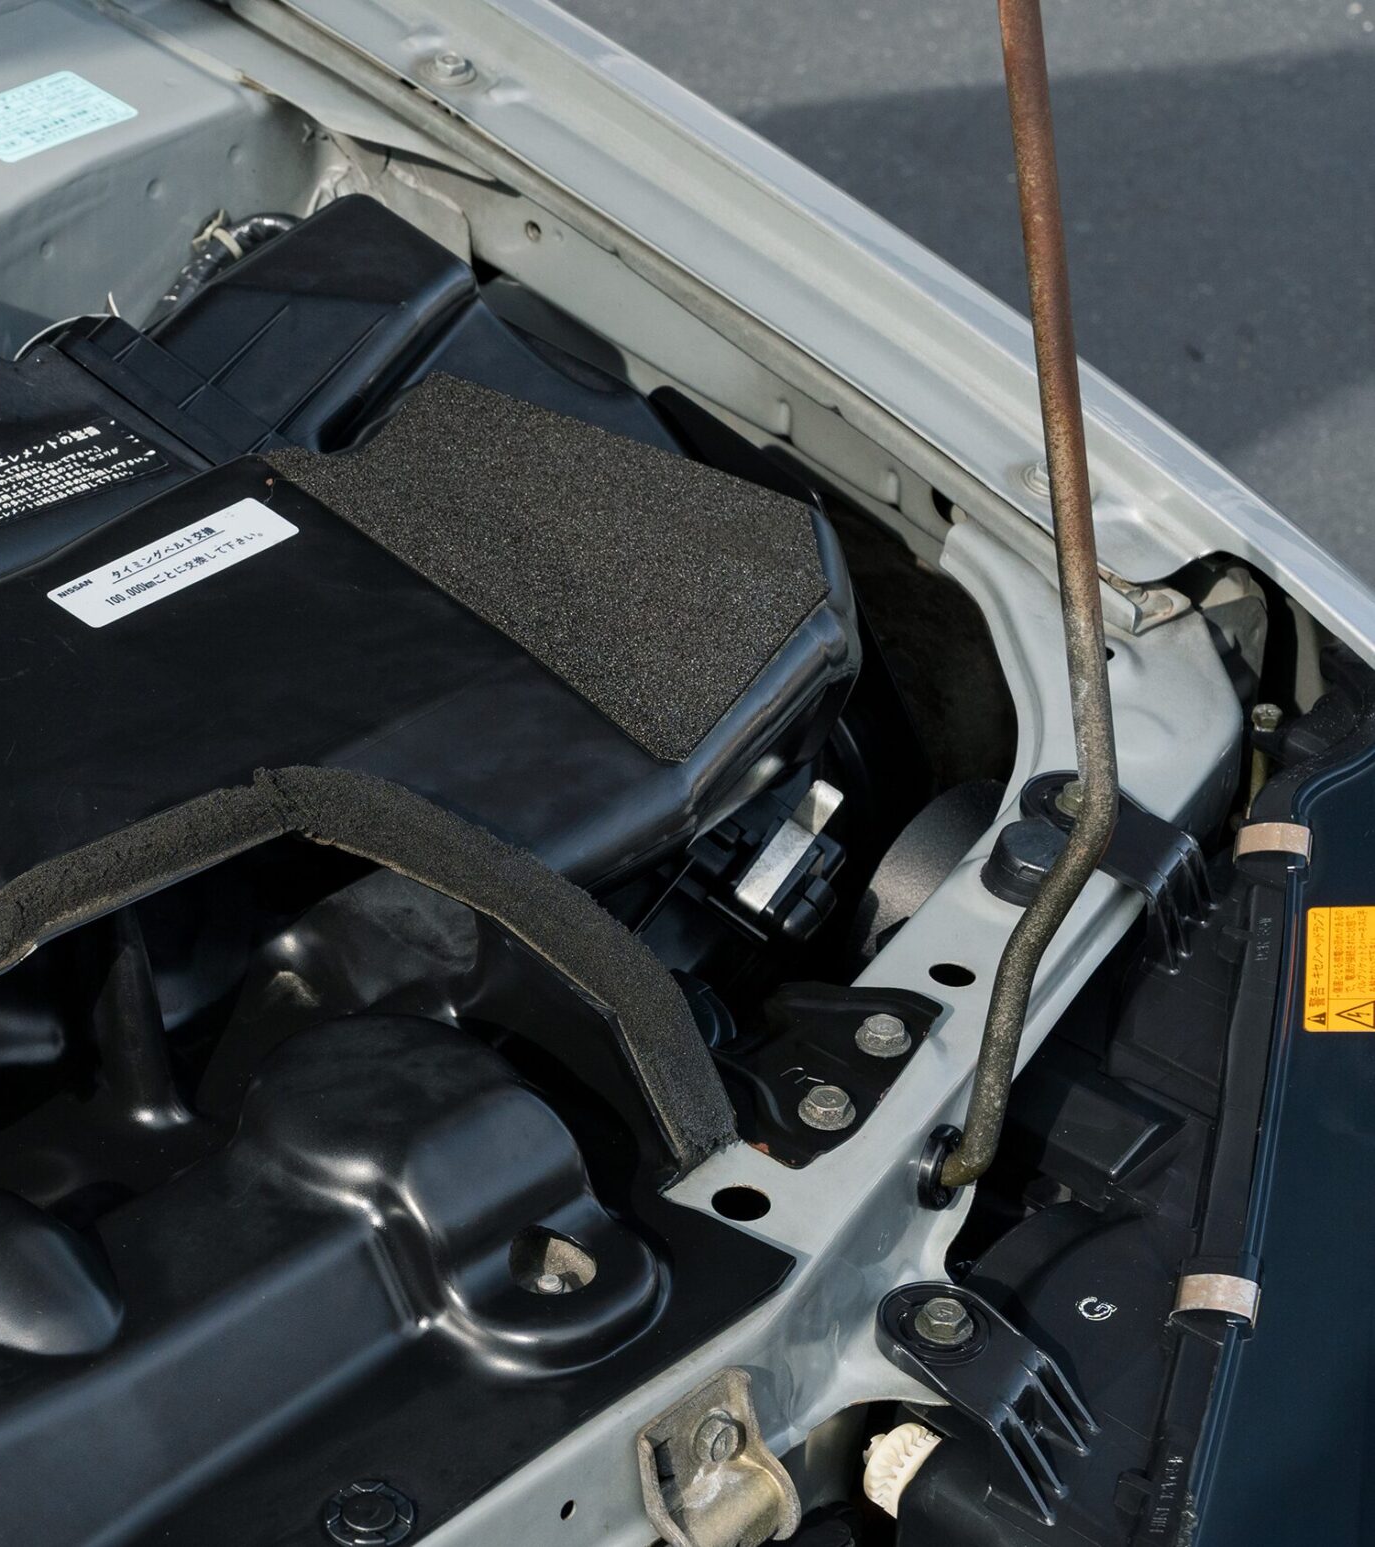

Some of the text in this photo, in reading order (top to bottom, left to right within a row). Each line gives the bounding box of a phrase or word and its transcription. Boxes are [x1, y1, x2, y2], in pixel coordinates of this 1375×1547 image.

[111, 526, 217, 580] タイミングベルト交換
[56, 578, 93, 599] NISSAN
